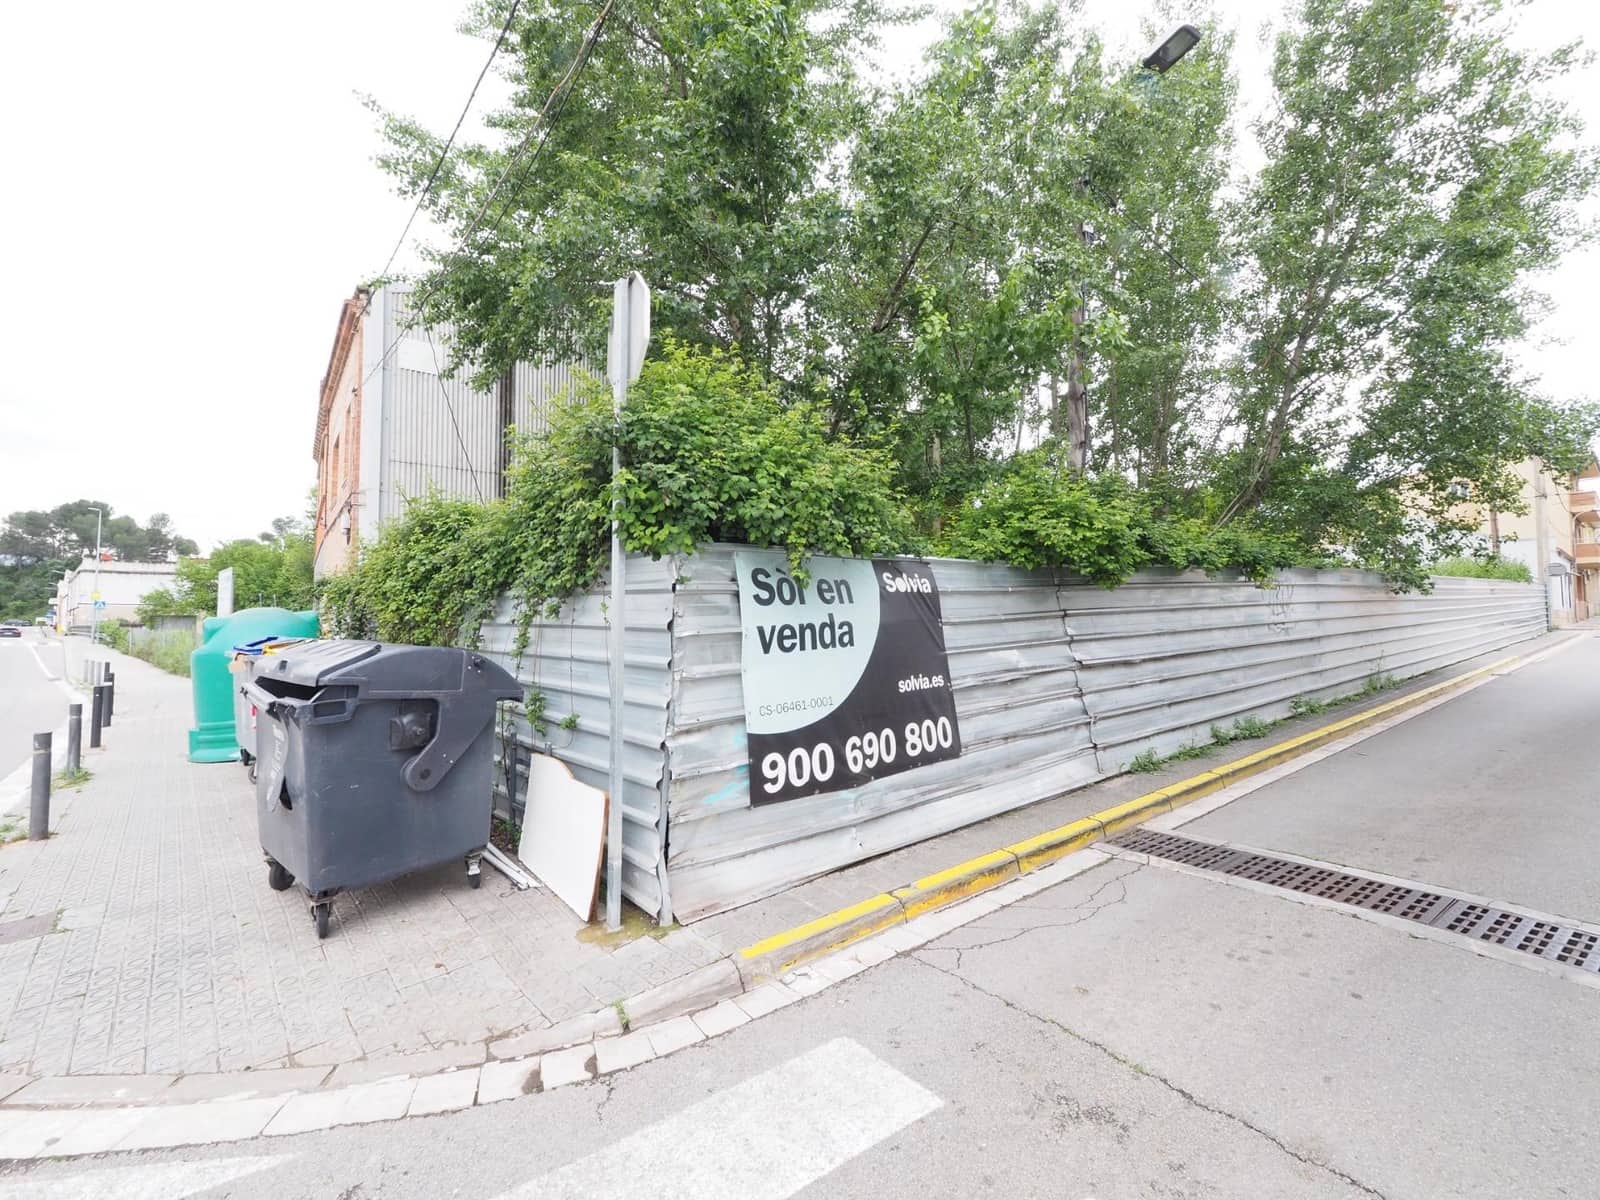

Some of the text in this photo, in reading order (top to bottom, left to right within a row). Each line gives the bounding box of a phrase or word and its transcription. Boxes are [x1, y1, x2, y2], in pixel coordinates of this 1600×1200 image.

[816, 578, 854, 605] en
[882, 572, 932, 593] Solvia
[756, 612, 855, 655] venda
[898, 673, 944, 693] solvia.es
[762, 716, 953, 794] 900 690 800
